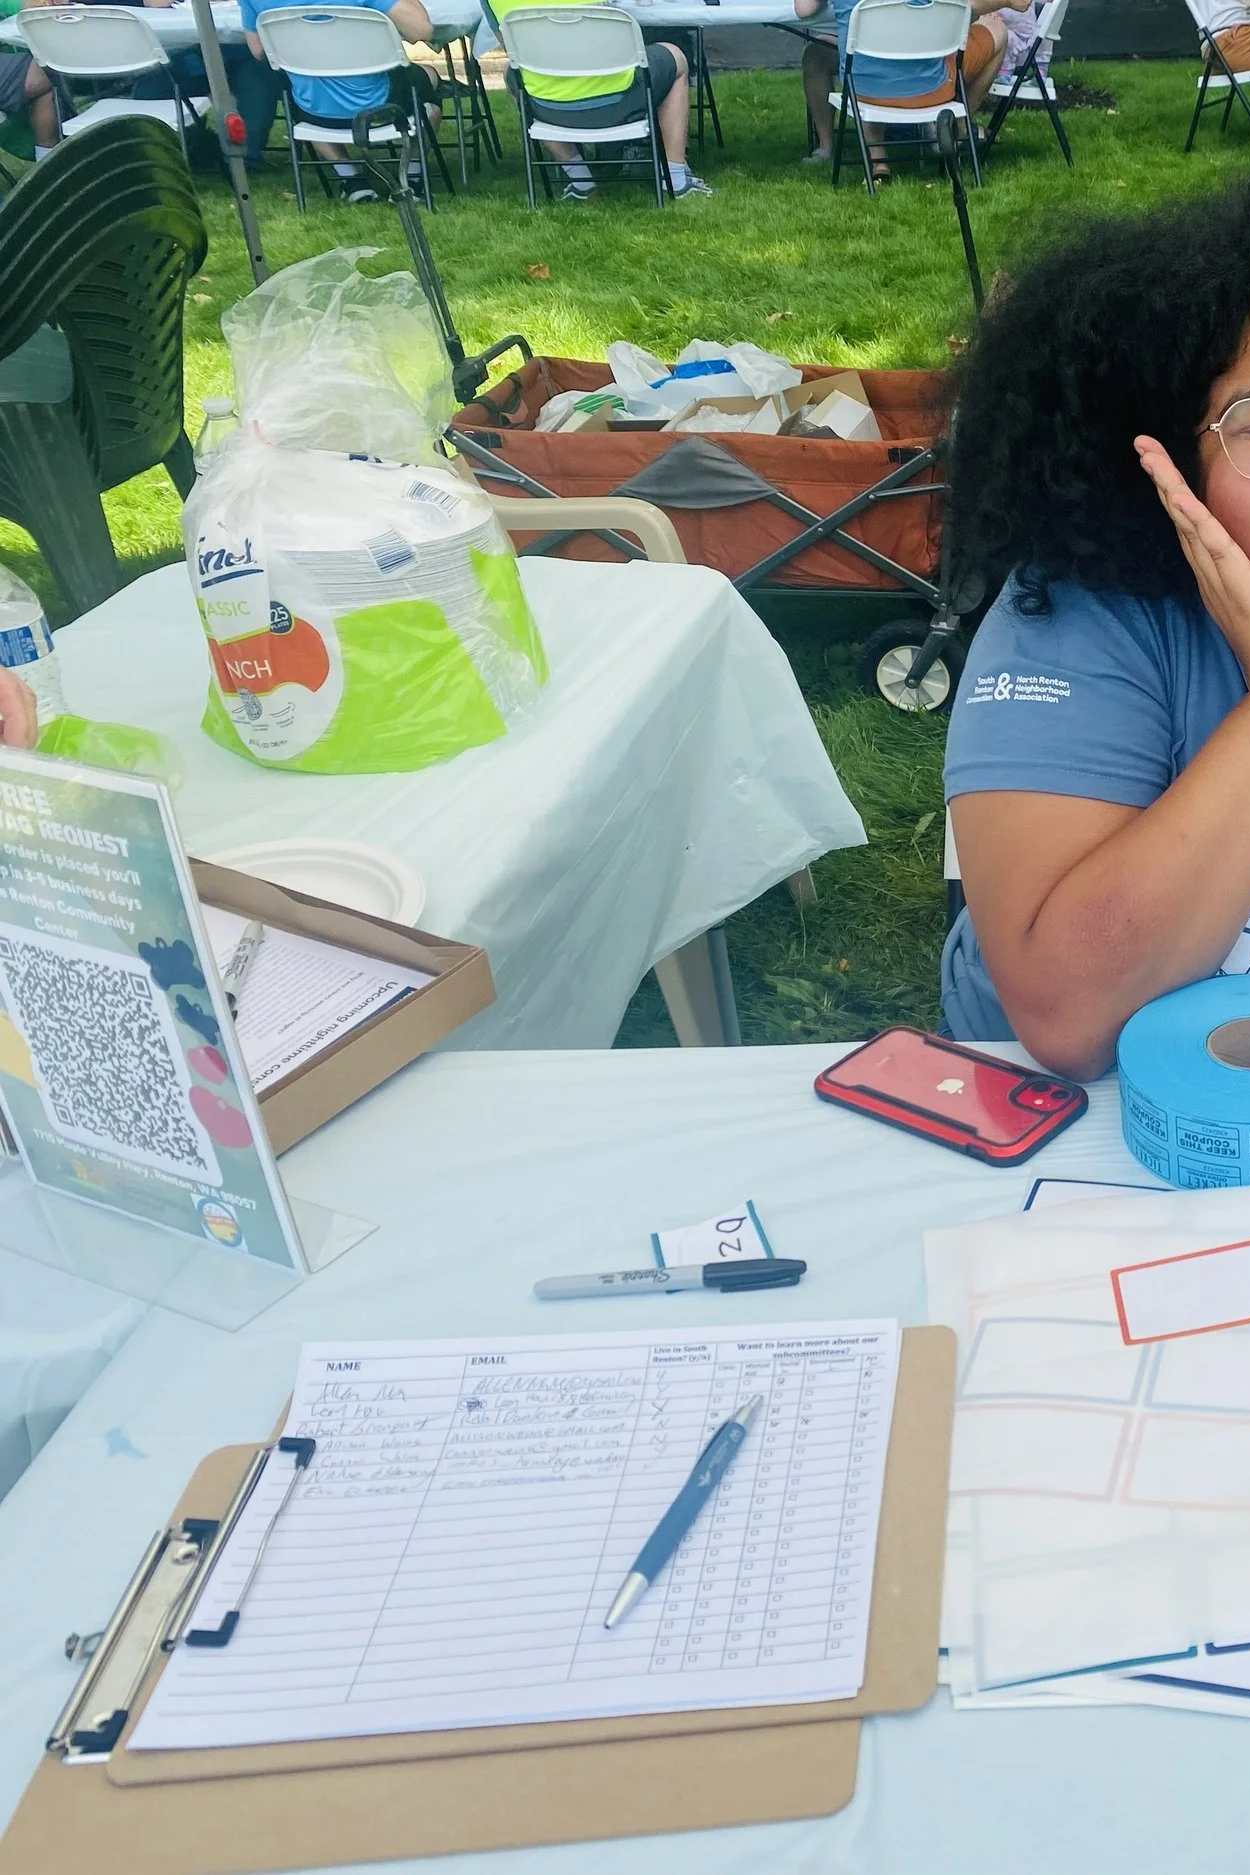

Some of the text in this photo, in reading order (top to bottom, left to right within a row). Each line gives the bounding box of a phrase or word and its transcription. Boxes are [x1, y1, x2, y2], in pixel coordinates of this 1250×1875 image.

[977, 675, 995, 685] South
[993, 672, 1013, 701] &
[1016, 675, 1070, 688] North Renton
[1015, 684, 1071, 697] Neighborhood
[1013, 693, 1059, 704] Association
[38, 819, 129, 858] REQUEST
[55, 854, 99, 877] placed
[47, 874, 106, 902] business
[108, 889, 142, 913] days
[8, 886, 55, 912] Renton
[57, 900, 135, 935] Community
[337, 980, 399, 1024] Upcoming
[281, 1022, 340, 1064] nighttime
[1179, 1138, 1236, 1156] KEEP THIS
[1184, 1132, 1230, 1148] COUPON
[654, 1346, 671, 1354] Live
[737, 1342, 763, 1350] Want
[776, 1340, 803, 1348] learn
[832, 1338, 860, 1346] about
[773, 1348, 851, 1359] subcommittees?
[326, 1362, 361, 1371] NAME
[471, 1356, 507, 1366] EMAIL
